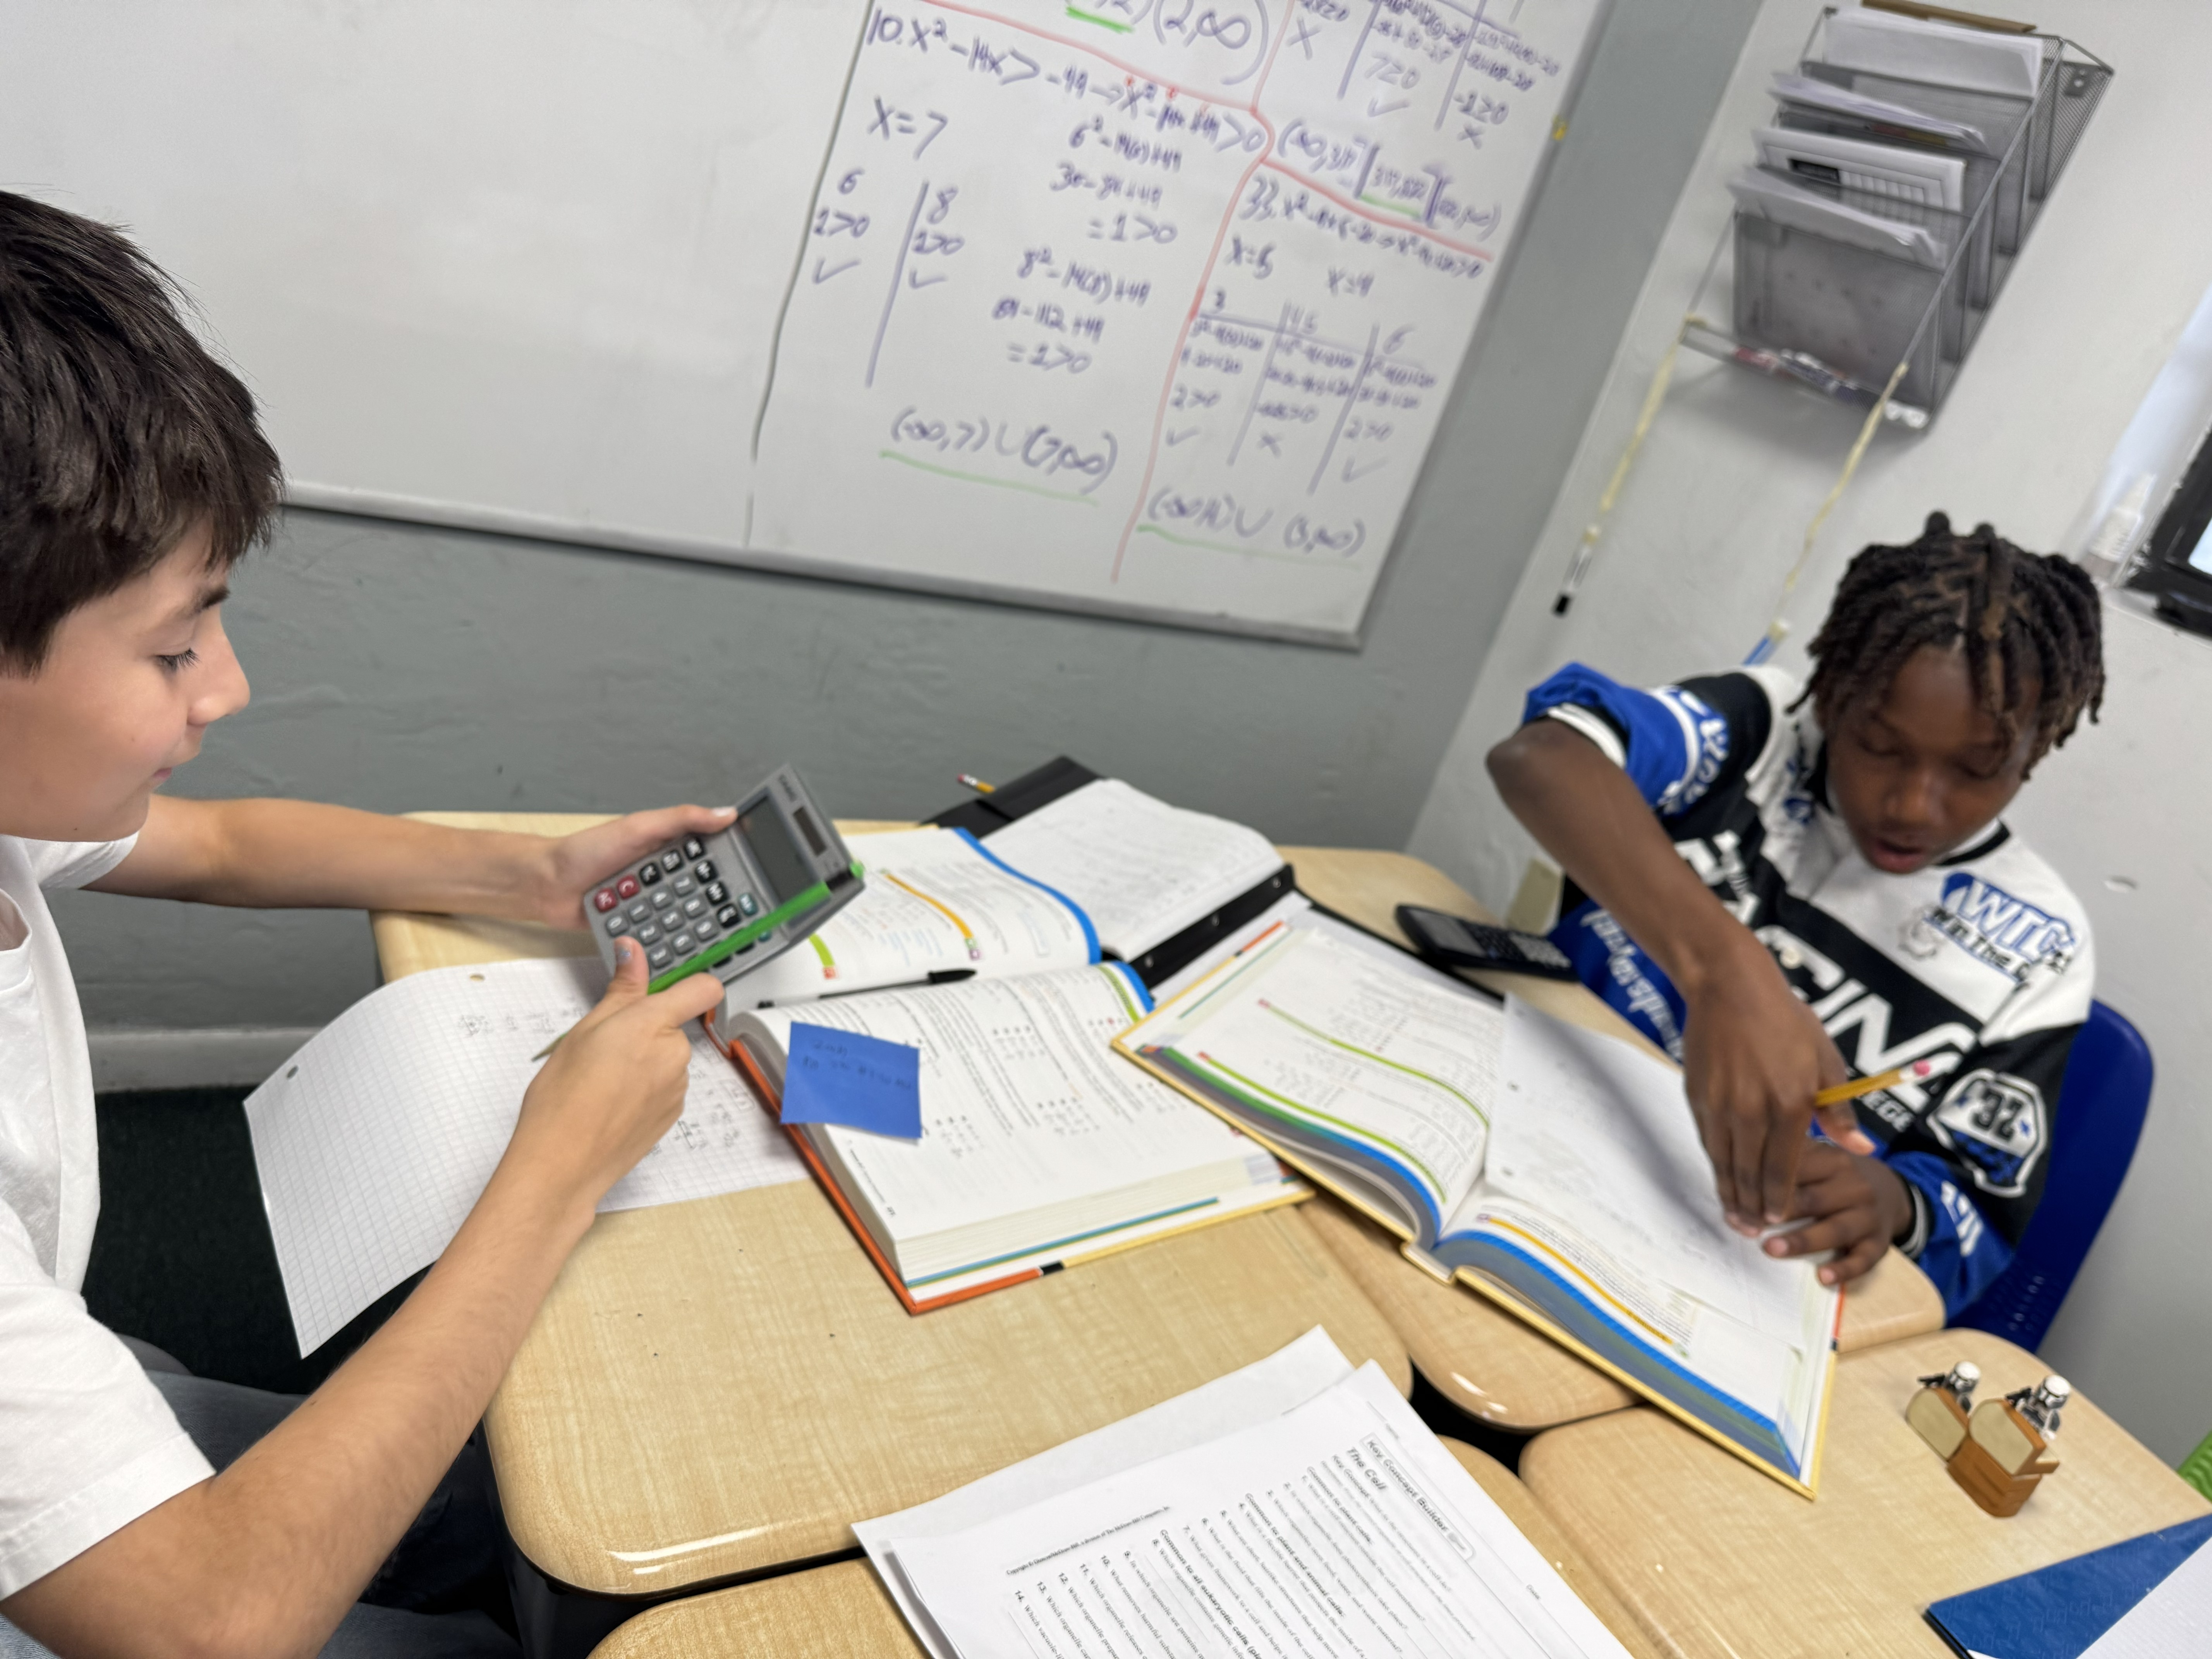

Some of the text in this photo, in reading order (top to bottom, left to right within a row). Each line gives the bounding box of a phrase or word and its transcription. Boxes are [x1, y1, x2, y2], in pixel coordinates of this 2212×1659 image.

[1346, 1447, 1388, 1491] The Cell
[1367, 1439, 1384, 1460] Key
[1383, 1459, 1419, 1501] Concept
[1416, 1497, 1449, 1532] Builder
[1245, 1493, 1273, 1527] Common
[1276, 1536, 1296, 1556] plant
[1293, 1556, 1309, 1571] and
[1305, 1571, 1329, 1597] animal
[1015, 1590, 1025, 1602] 14.
[1024, 1604, 1040, 1628] Which
[1037, 1581, 1047, 1594] 13.
[1046, 1595, 1062, 1618] Which
[1060, 1618, 1082, 1649] organelle
[1058, 1572, 1068, 1585] 12.
[1068, 1586, 1084, 1609] Which
[1081, 1608, 1104, 1639] organelle
[1079, 1563, 1147, 1659] 11. Which organelle releases
[1110, 1569, 1124, 1587] What
[1121, 1587, 1142, 1614] removes
[1140, 1613, 1162, 1640] harmful
[1160, 1529, 1187, 1565] Common
[1192, 1575, 1203, 1585] all
[1200, 1585, 1234, 1626] eukaryotic
[1232, 1626, 1249, 1646] cells
